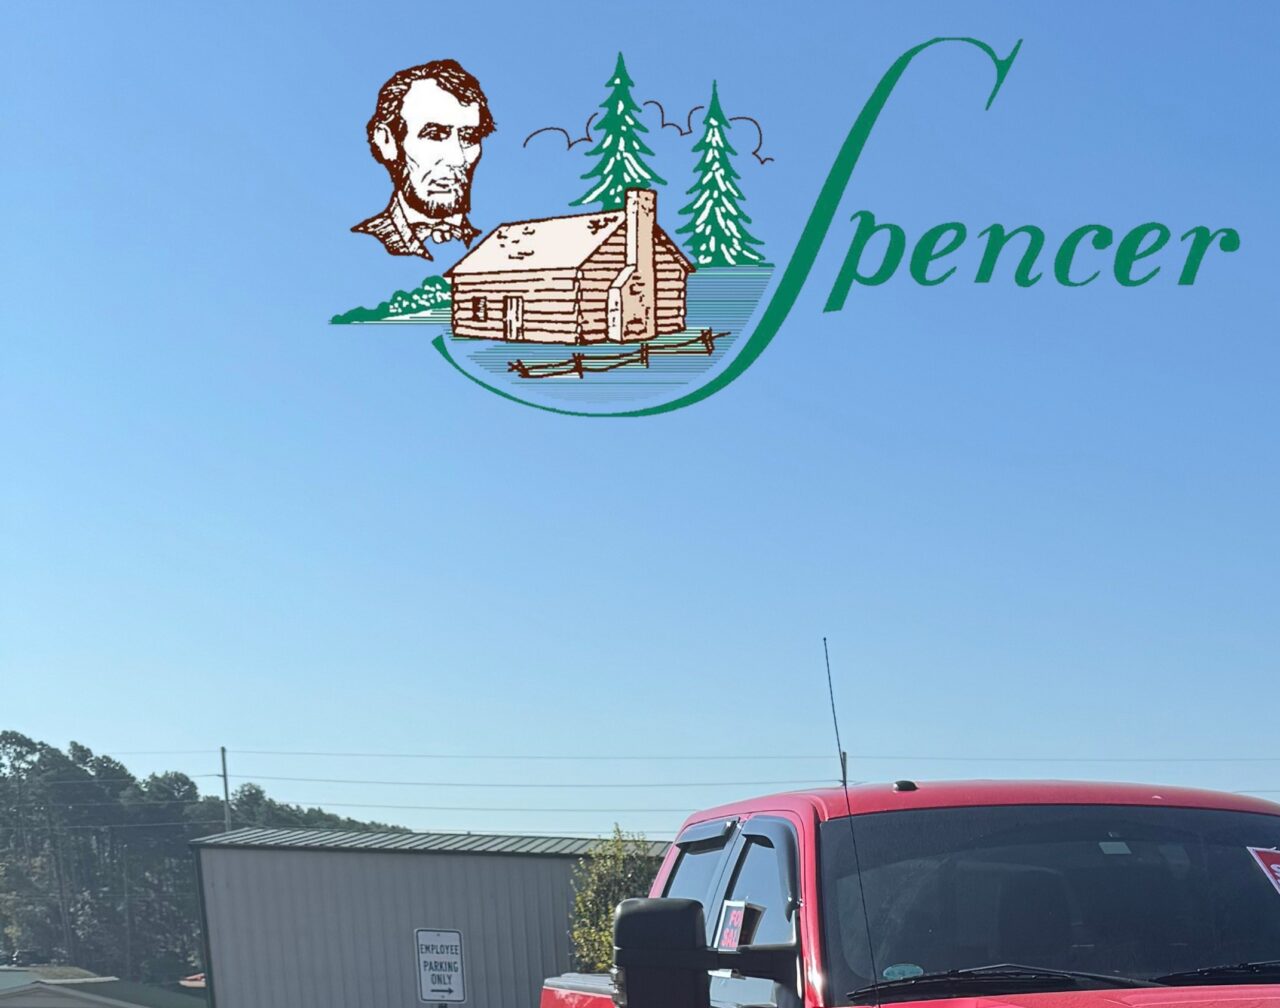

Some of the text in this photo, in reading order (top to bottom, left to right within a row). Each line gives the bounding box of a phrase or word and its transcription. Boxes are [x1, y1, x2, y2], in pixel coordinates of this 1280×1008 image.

[420, 943, 460, 956] EMPLOYEE
[423, 960, 459, 973] PARKING
[430, 973, 453, 986] ONLY
